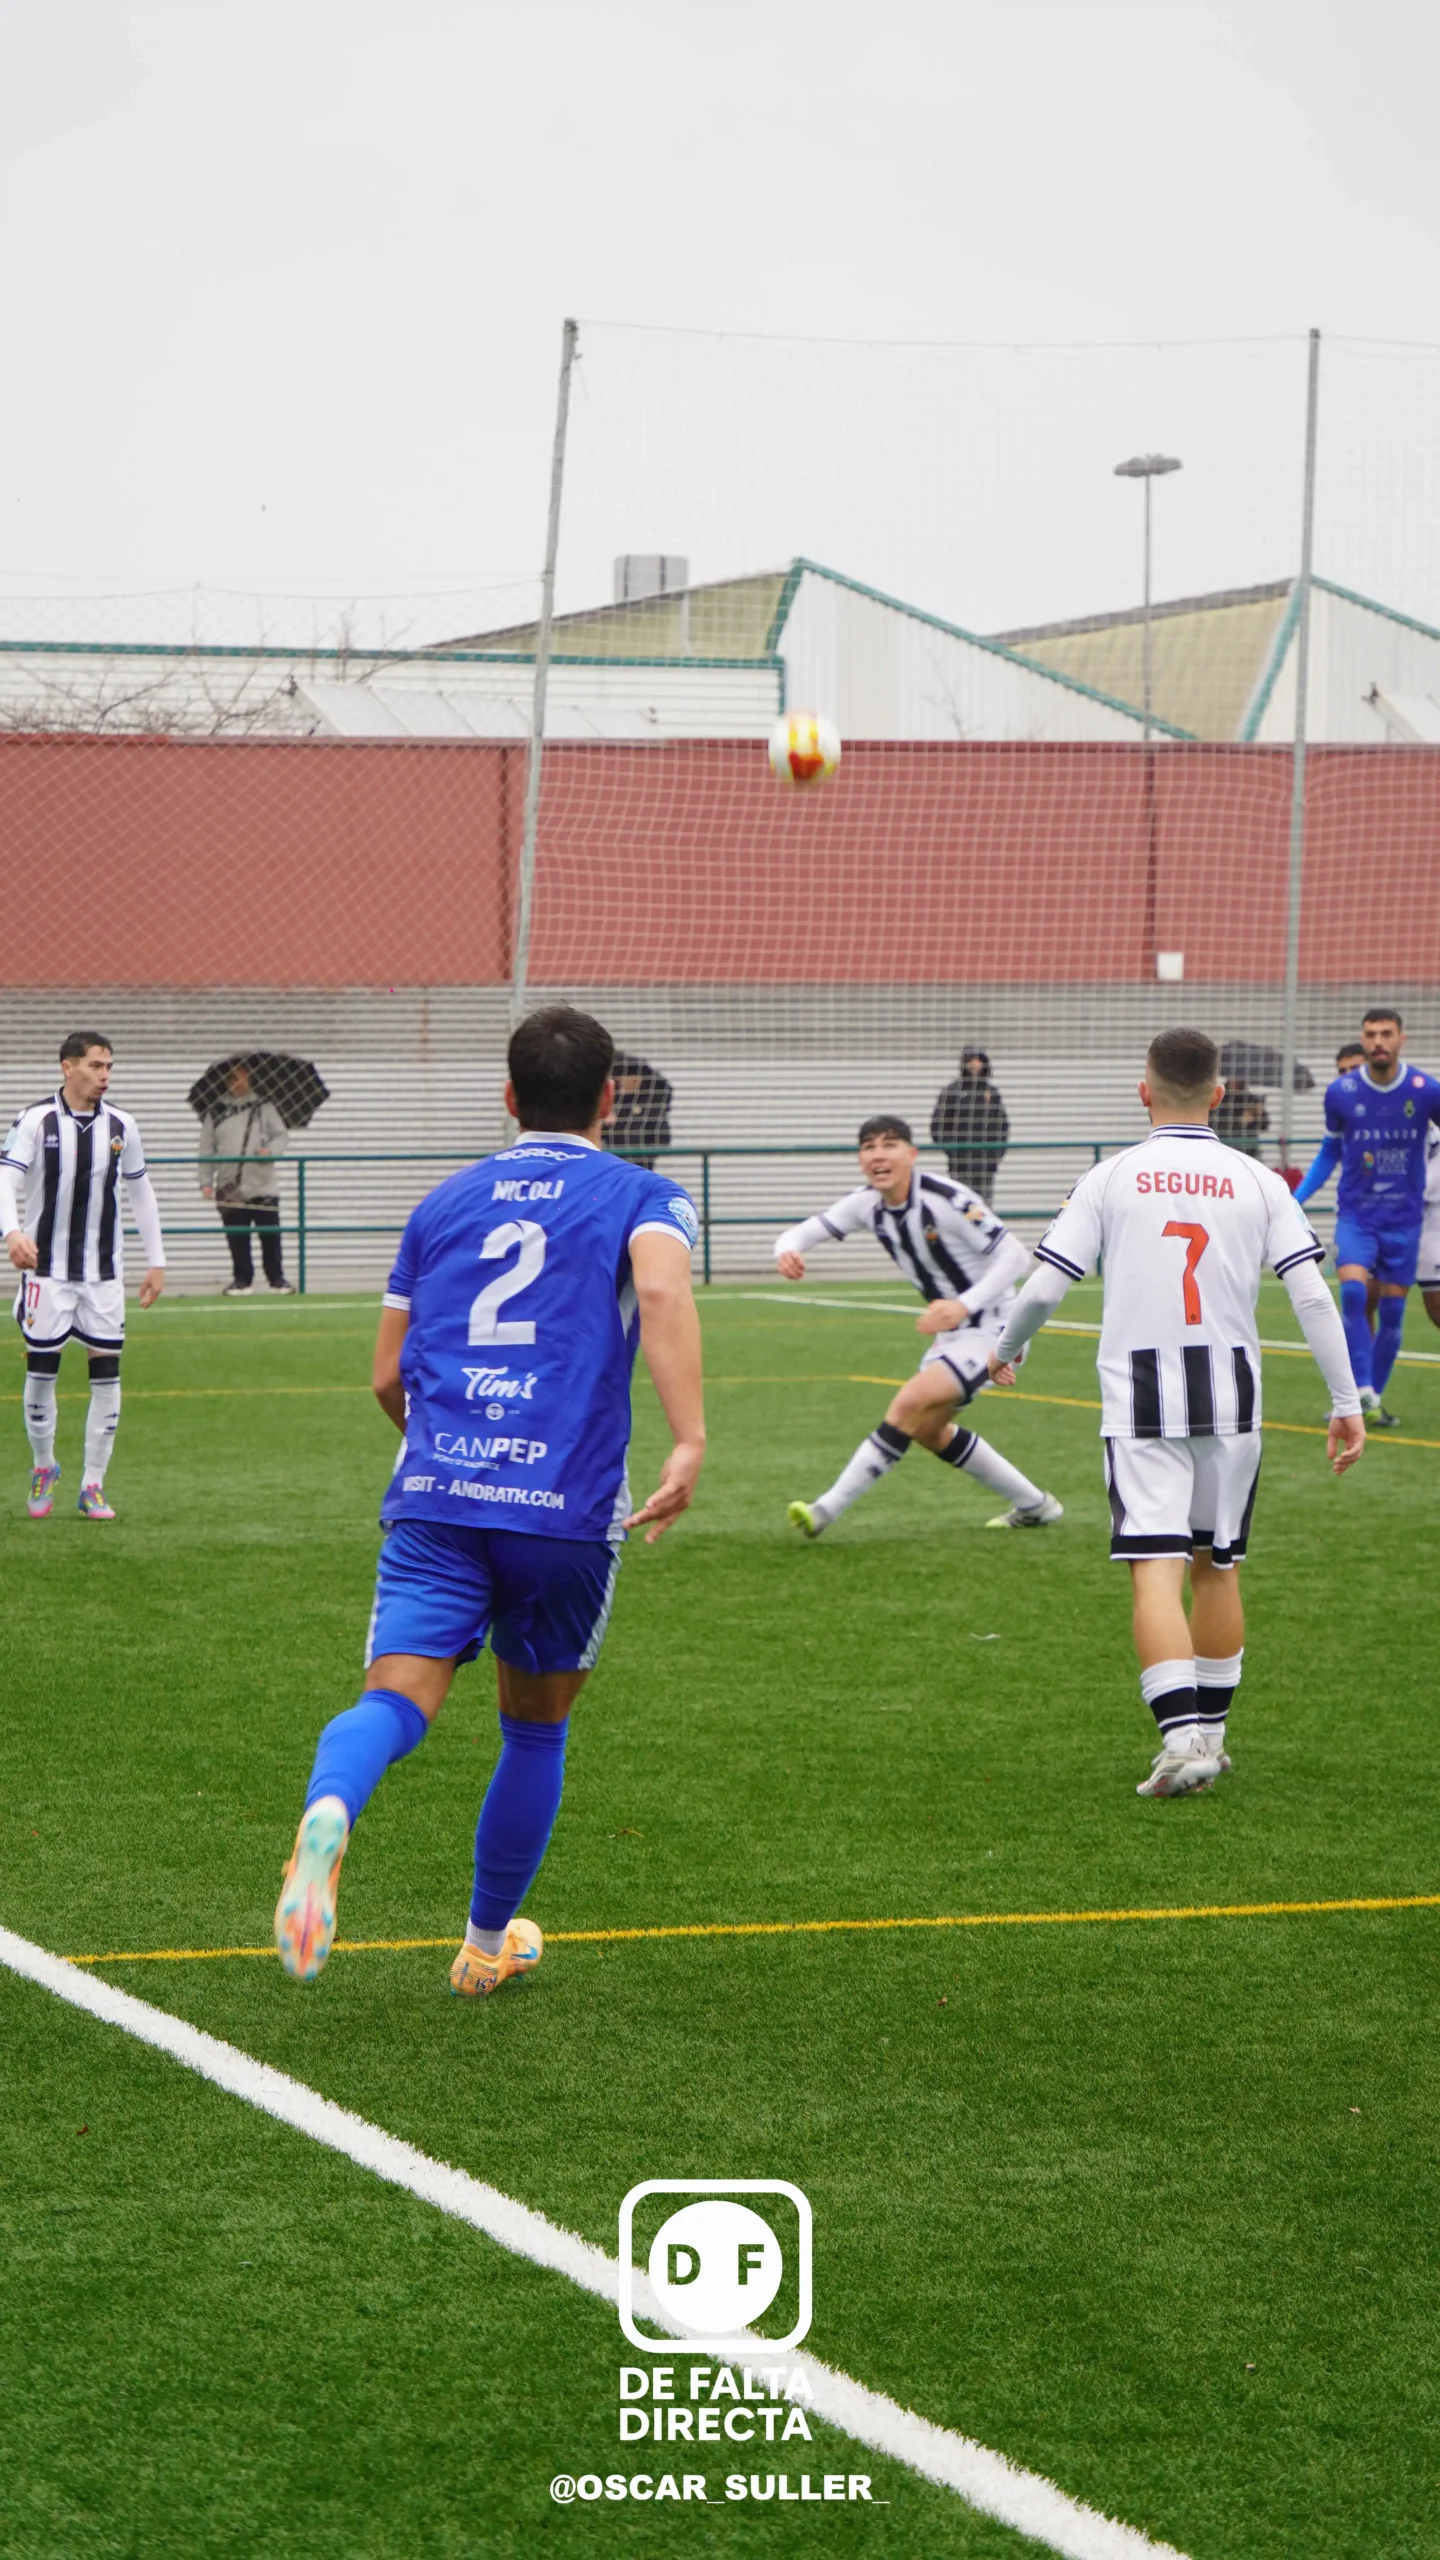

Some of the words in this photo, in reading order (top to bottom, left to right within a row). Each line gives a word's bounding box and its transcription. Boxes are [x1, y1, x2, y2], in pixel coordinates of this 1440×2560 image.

[491, 1180, 565, 1202] NICOLI
[1136, 1172, 1235, 1199] SEGURA
[468, 1219, 547, 1346] 2
[1161, 1221, 1210, 1326] 7
[461, 1366, 538, 1400] Tim's
